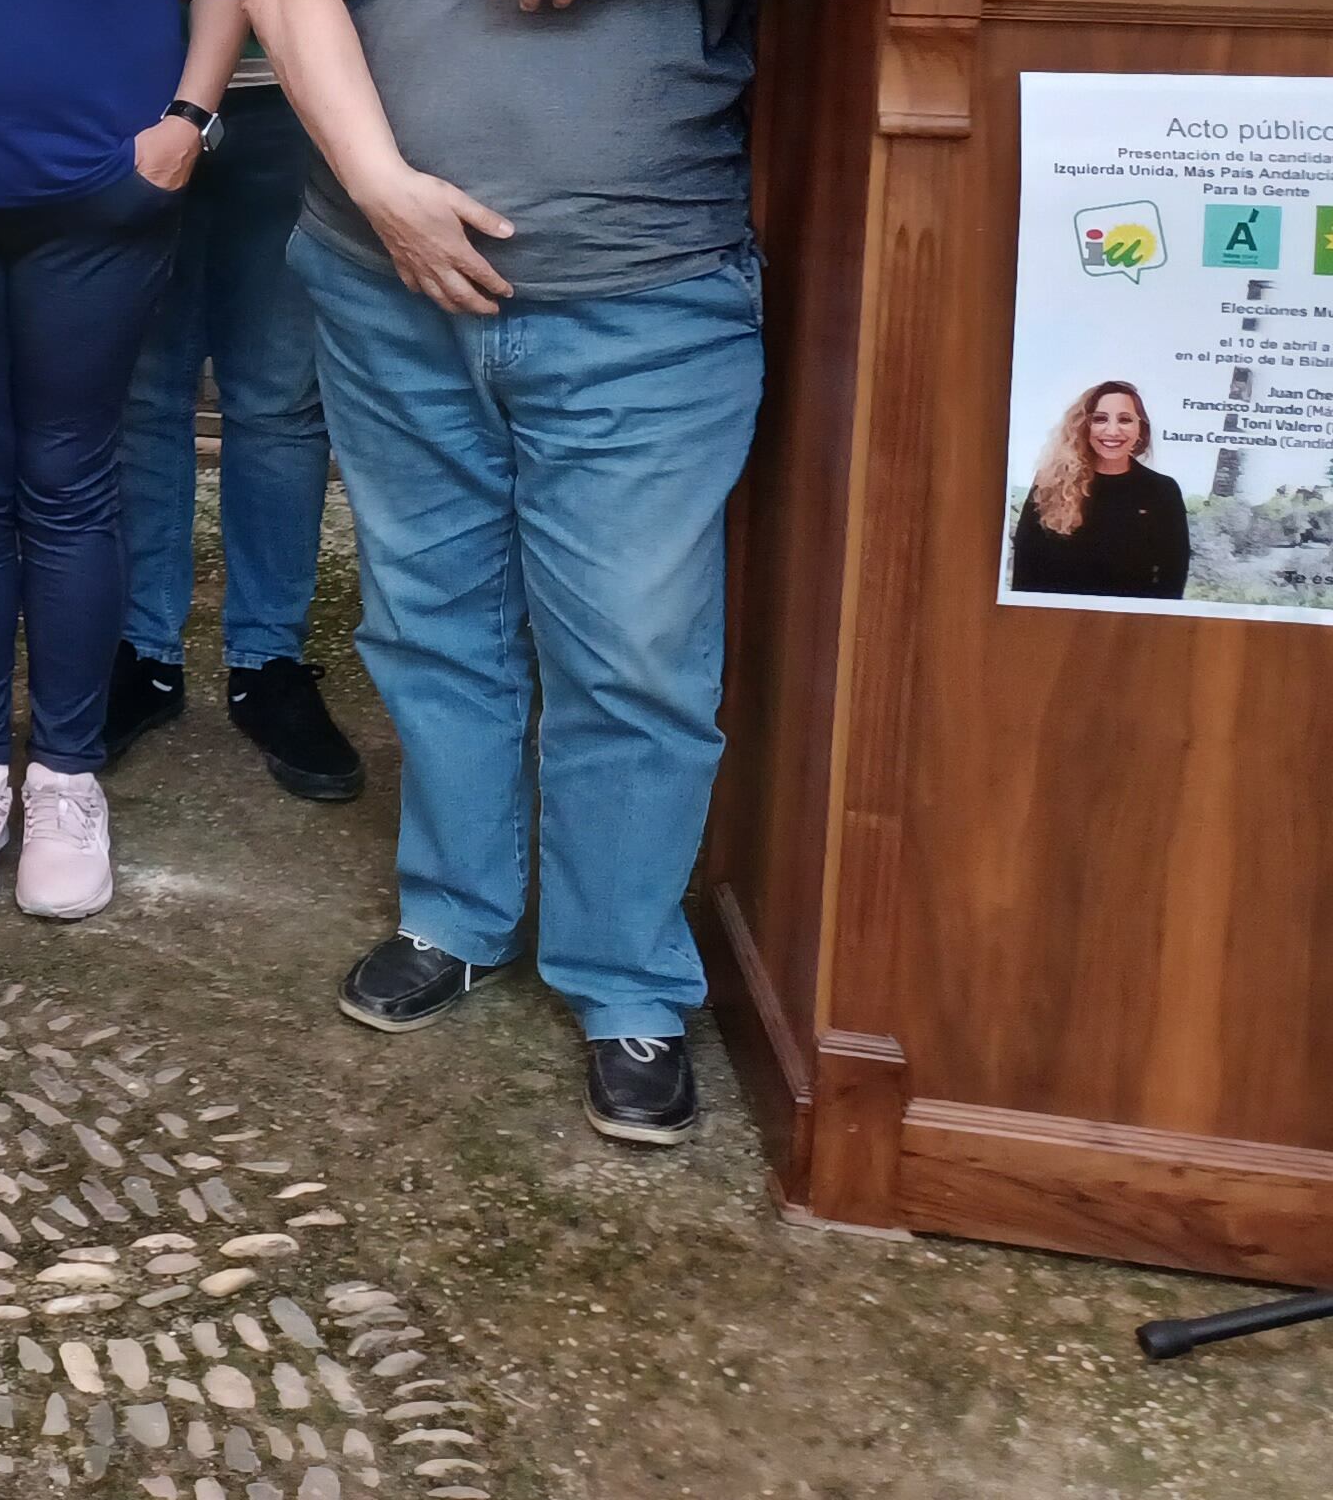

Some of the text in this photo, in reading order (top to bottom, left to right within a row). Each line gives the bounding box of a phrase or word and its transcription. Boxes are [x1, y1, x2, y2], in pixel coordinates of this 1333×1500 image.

[1166, 117, 1228, 139] Acto
[1118, 147, 1333, 164] Presentación de la candida
[1054, 162, 1124, 176] Izquierda
[1129, 164, 1178, 177] Unida,
[1184, 166, 1215, 178] Más
[1220, 166, 1254, 179] País
[1203, 183, 1310, 197] Para la Gente
[1221, 302, 1308, 318] Elecciones
[1219, 337, 1232, 347] el
[1239, 338, 1255, 349] 10
[1259, 338, 1278, 350] de
[1283, 340, 1317, 351] abril
[1175, 352, 1193, 361] en
[1197, 351, 1210, 361] el
[1215, 353, 1253, 365] patio
[1257, 354, 1276, 366] de
[1281, 355, 1294, 366] la
[1267, 387, 1303, 399] Juan
[1182, 398, 1249, 412] Francisco
[1253, 402, 1304, 415] Jurado
[1241, 417, 1272, 430] Toni
[1275, 419, 1323, 432] Valero
[1162, 429, 1203, 443] Laura
[1206, 431, 1278, 447] Cerezuela
